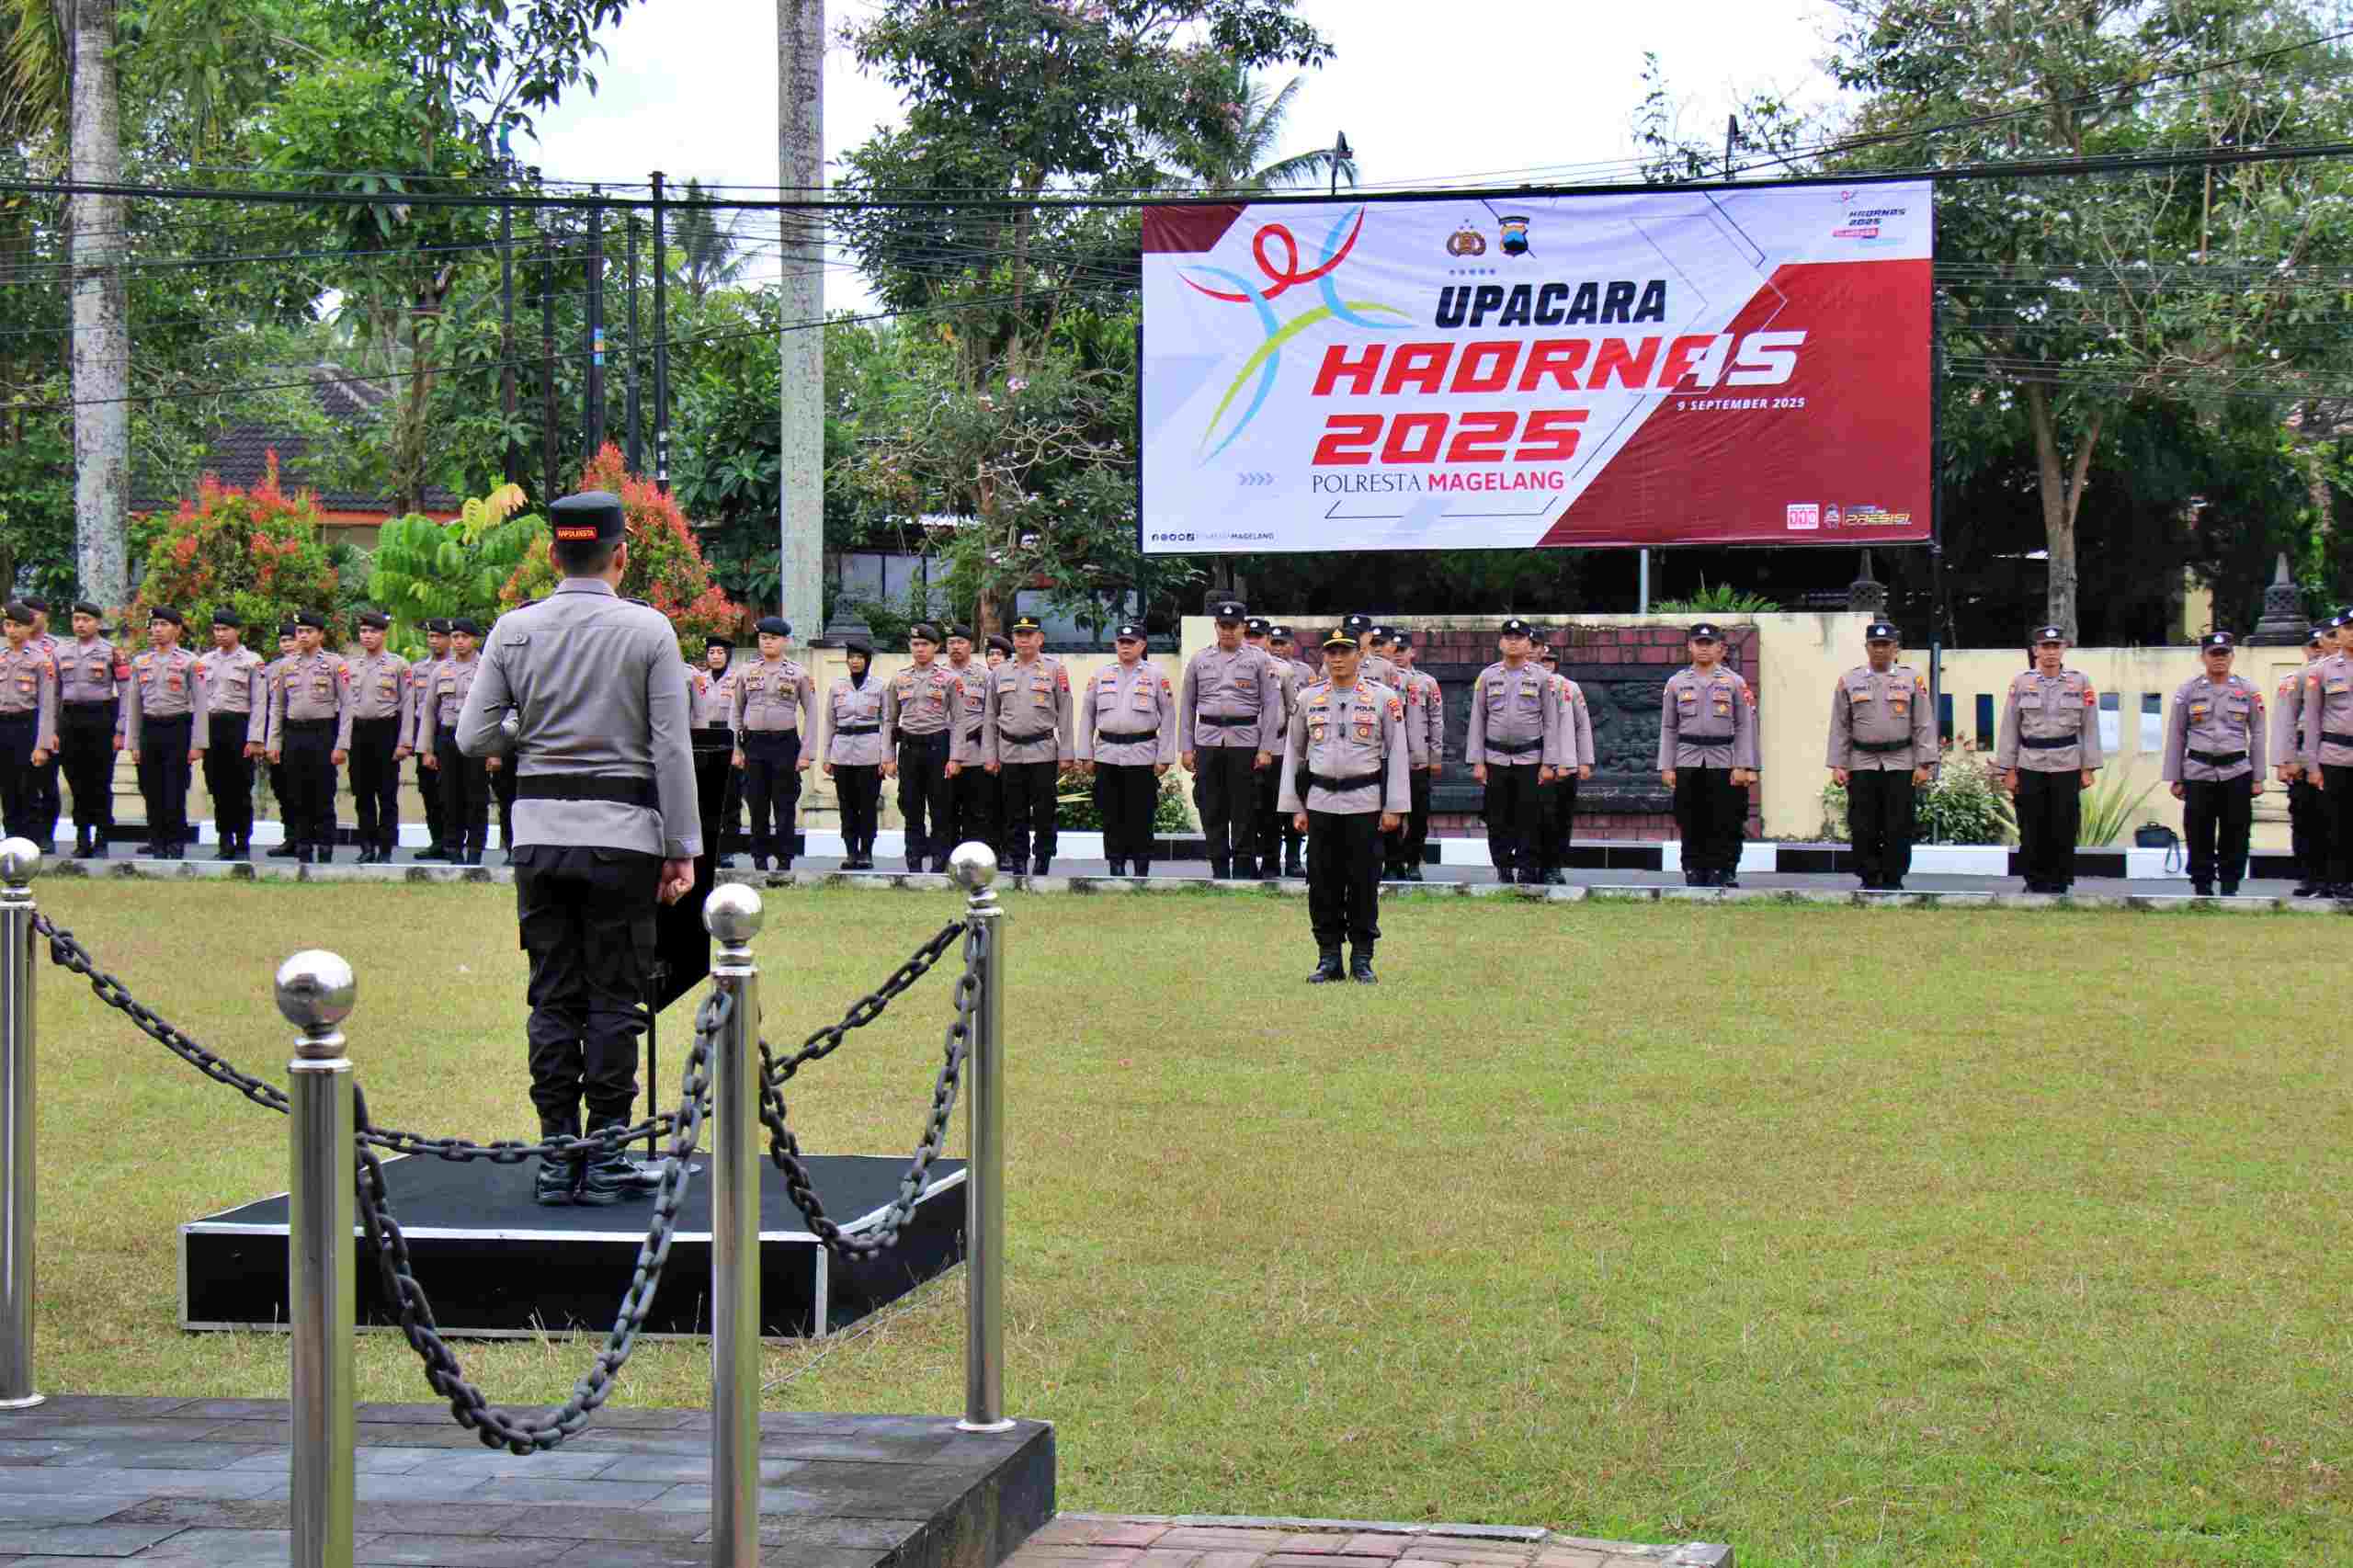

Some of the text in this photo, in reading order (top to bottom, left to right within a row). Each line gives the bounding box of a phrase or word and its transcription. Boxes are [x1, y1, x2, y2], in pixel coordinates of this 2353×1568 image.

[1434, 279, 1666, 329] UPACARA
[1311, 330, 1808, 396] HAORNAS
[1676, 396, 1806, 412] 9 SEPTEMBER 2025
[1311, 409, 1590, 465] 2025
[1312, 470, 1564, 494] POLRESTA MAGELANG
